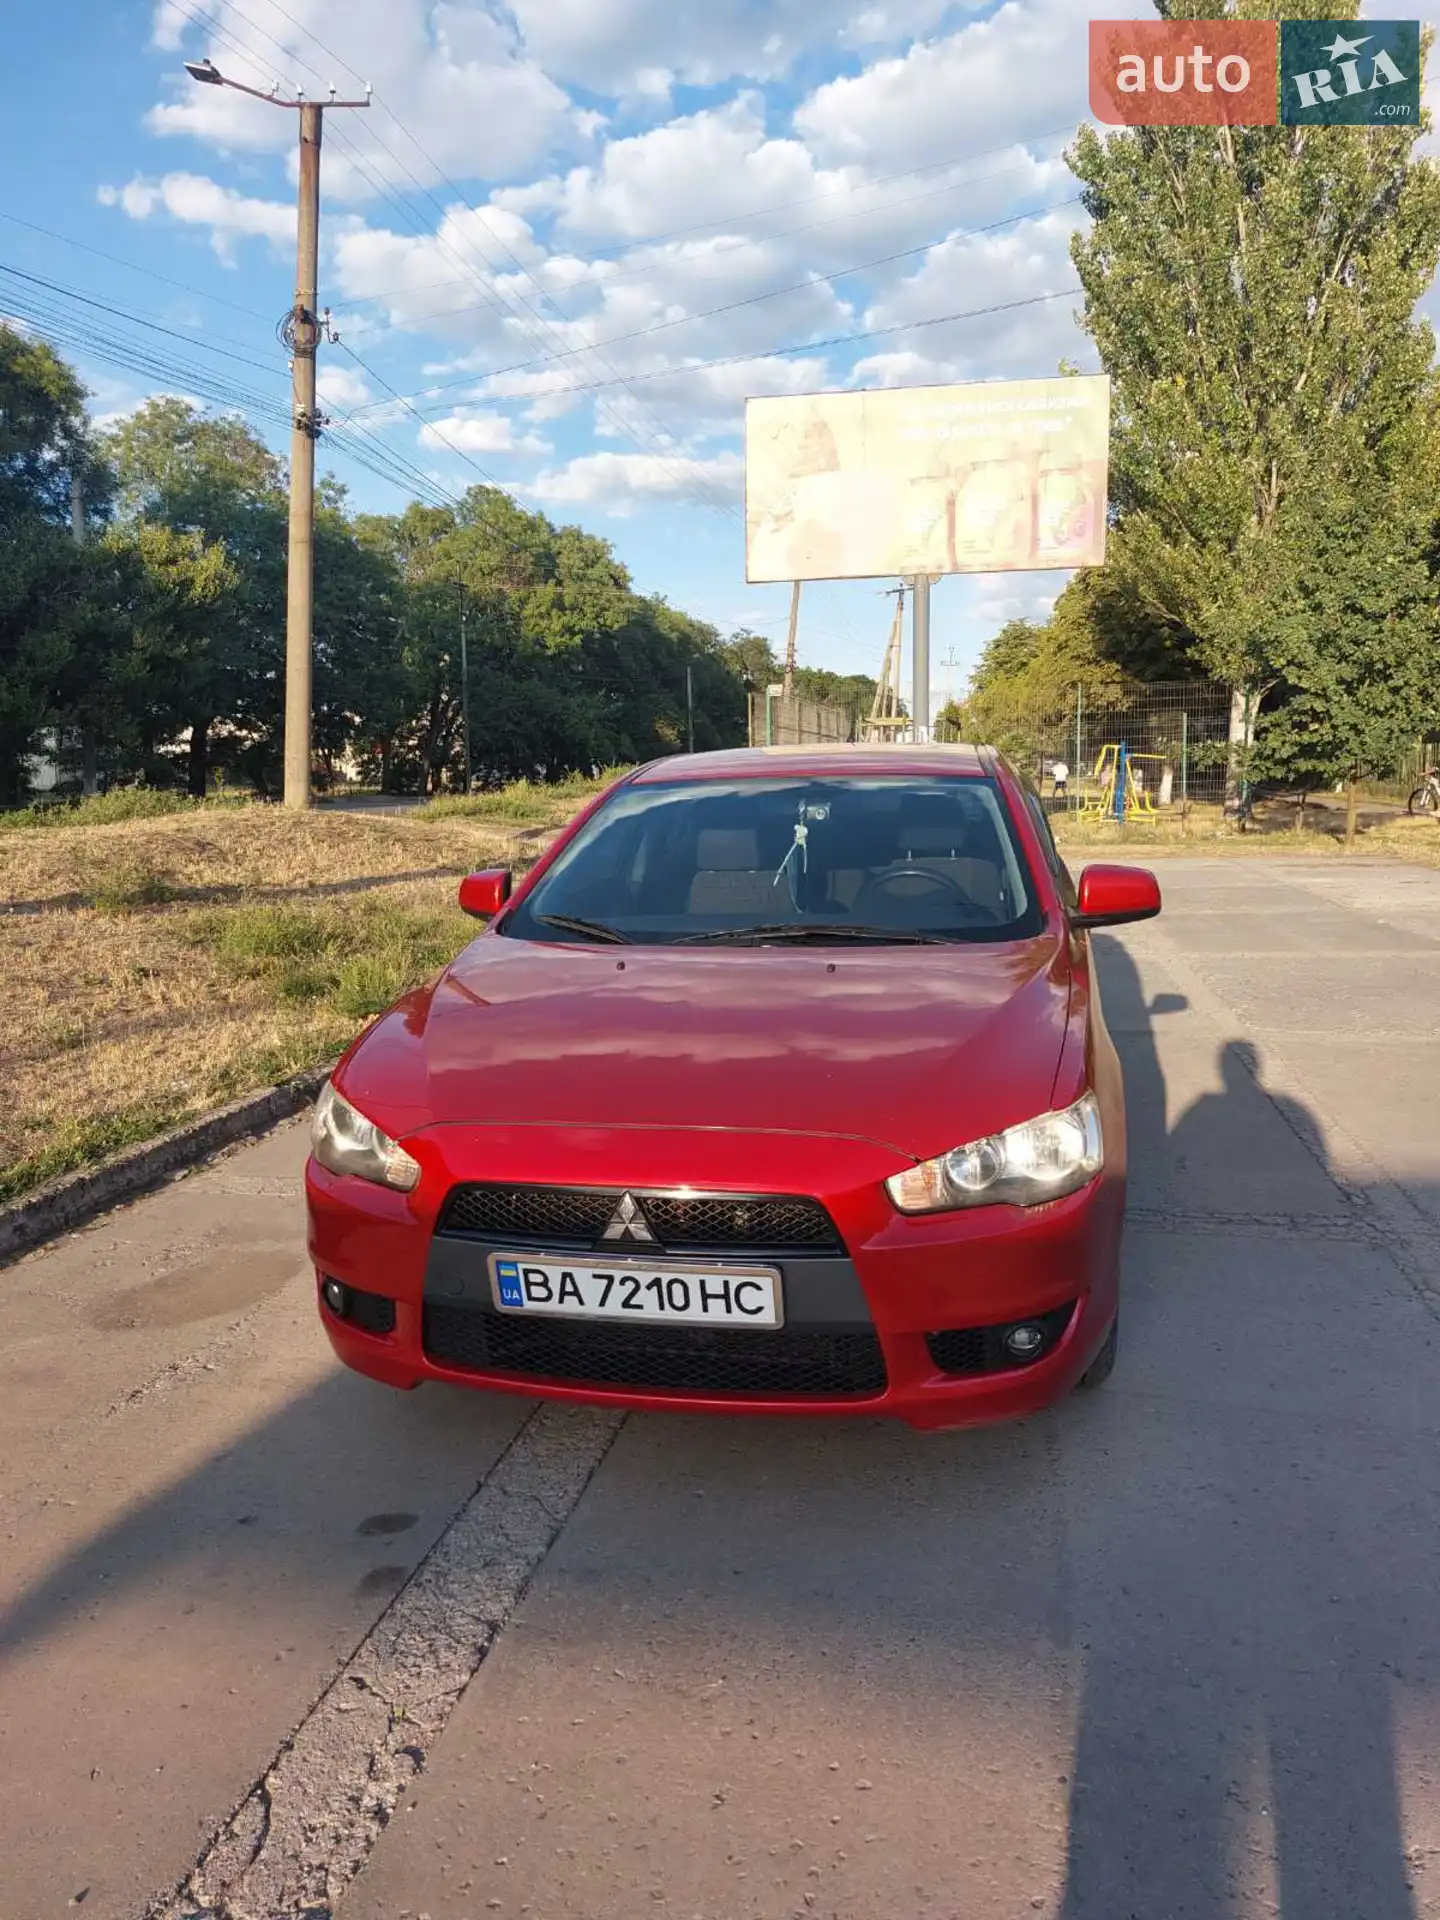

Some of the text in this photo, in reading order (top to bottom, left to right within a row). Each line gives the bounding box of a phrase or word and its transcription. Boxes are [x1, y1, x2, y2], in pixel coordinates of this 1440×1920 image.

[502, 1288, 521, 1300] UA
[522, 1268, 765, 1315] BA 7210 HC
